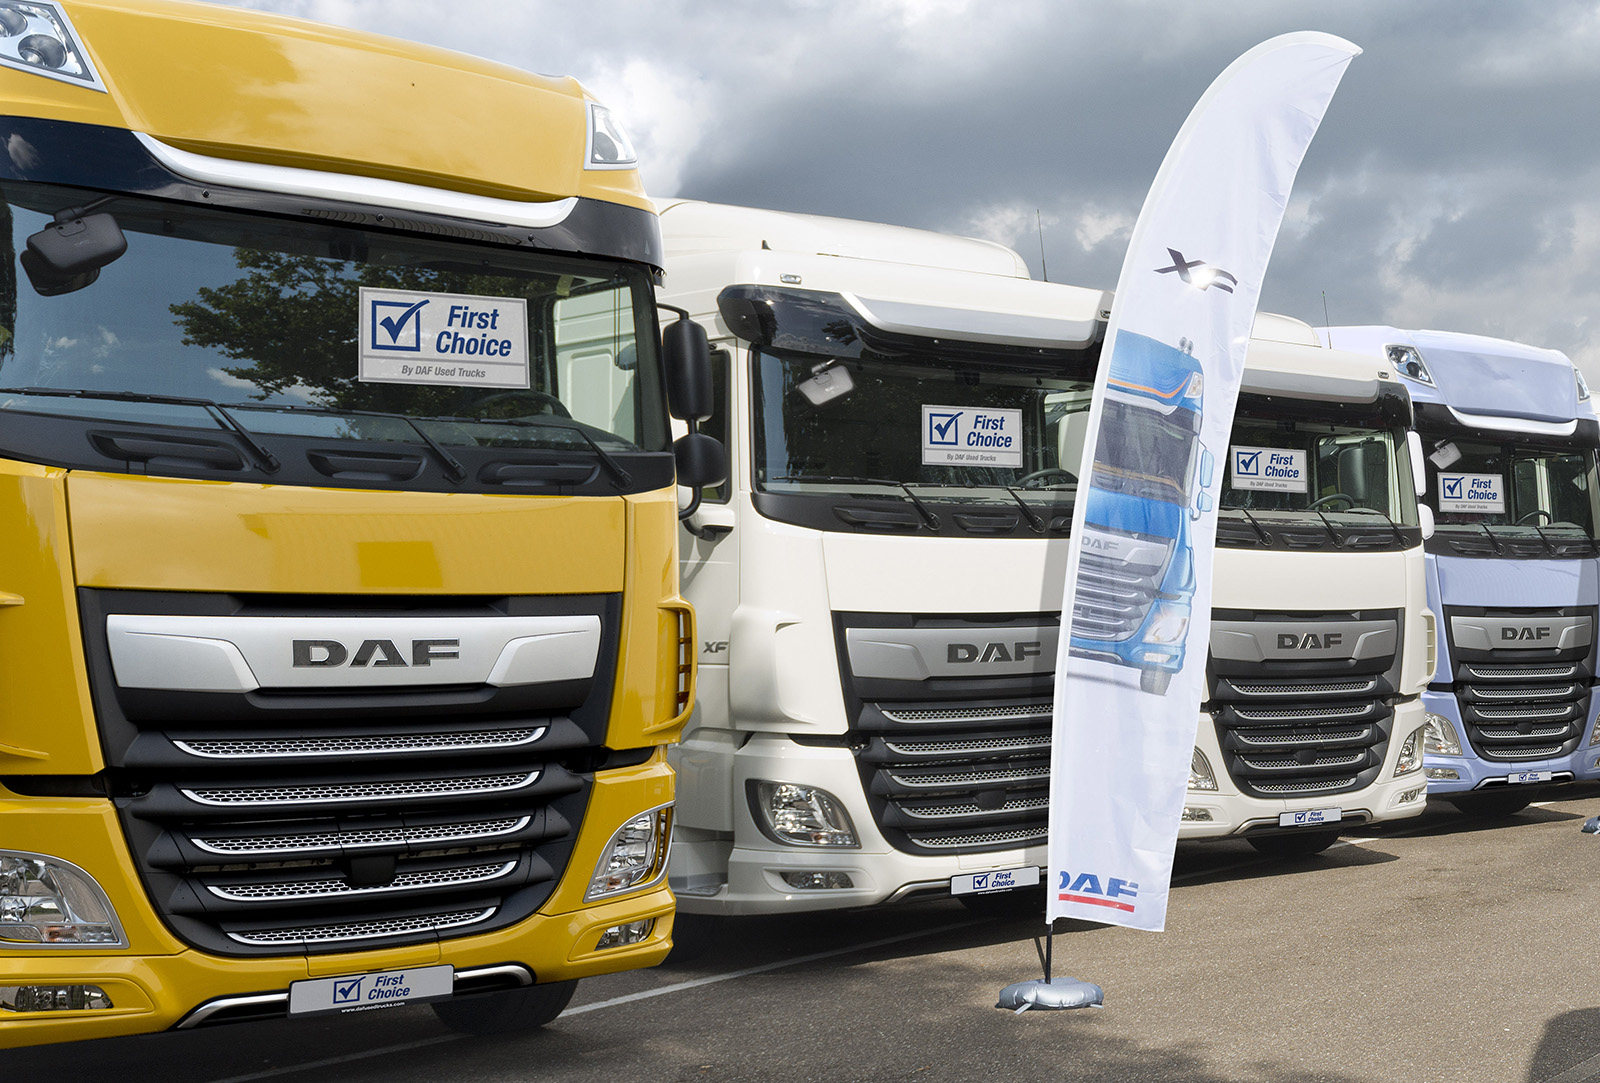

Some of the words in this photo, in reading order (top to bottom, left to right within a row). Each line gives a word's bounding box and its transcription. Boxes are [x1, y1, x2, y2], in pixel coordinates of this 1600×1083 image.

[447, 305, 500, 330] First
[436, 330, 512, 357] Choice
[402, 365, 414, 376] By
[415, 366, 433, 375] DAF
[434, 366, 456, 376] Used
[458, 367, 486, 378] Trucks
[974, 415, 1005, 430] First
[967, 432, 1012, 448] Choice
[1270, 454, 1294, 466] First
[1264, 466, 1299, 478] Choice
[1472, 478, 1492, 488] First
[1468, 489, 1497, 500] Choice
[1082, 536, 1120, 551] DAF
[1501, 627, 1550, 640] DAF
[703, 642, 729, 653] XF
[1276, 632, 1342, 650] DAF
[292, 638, 460, 668] DAF
[946, 641, 1042, 663] DAF
[995, 872, 1012, 880] First
[992, 879, 1015, 888] Choice
[375, 974, 404, 988] First
[368, 987, 410, 1000] Choice
